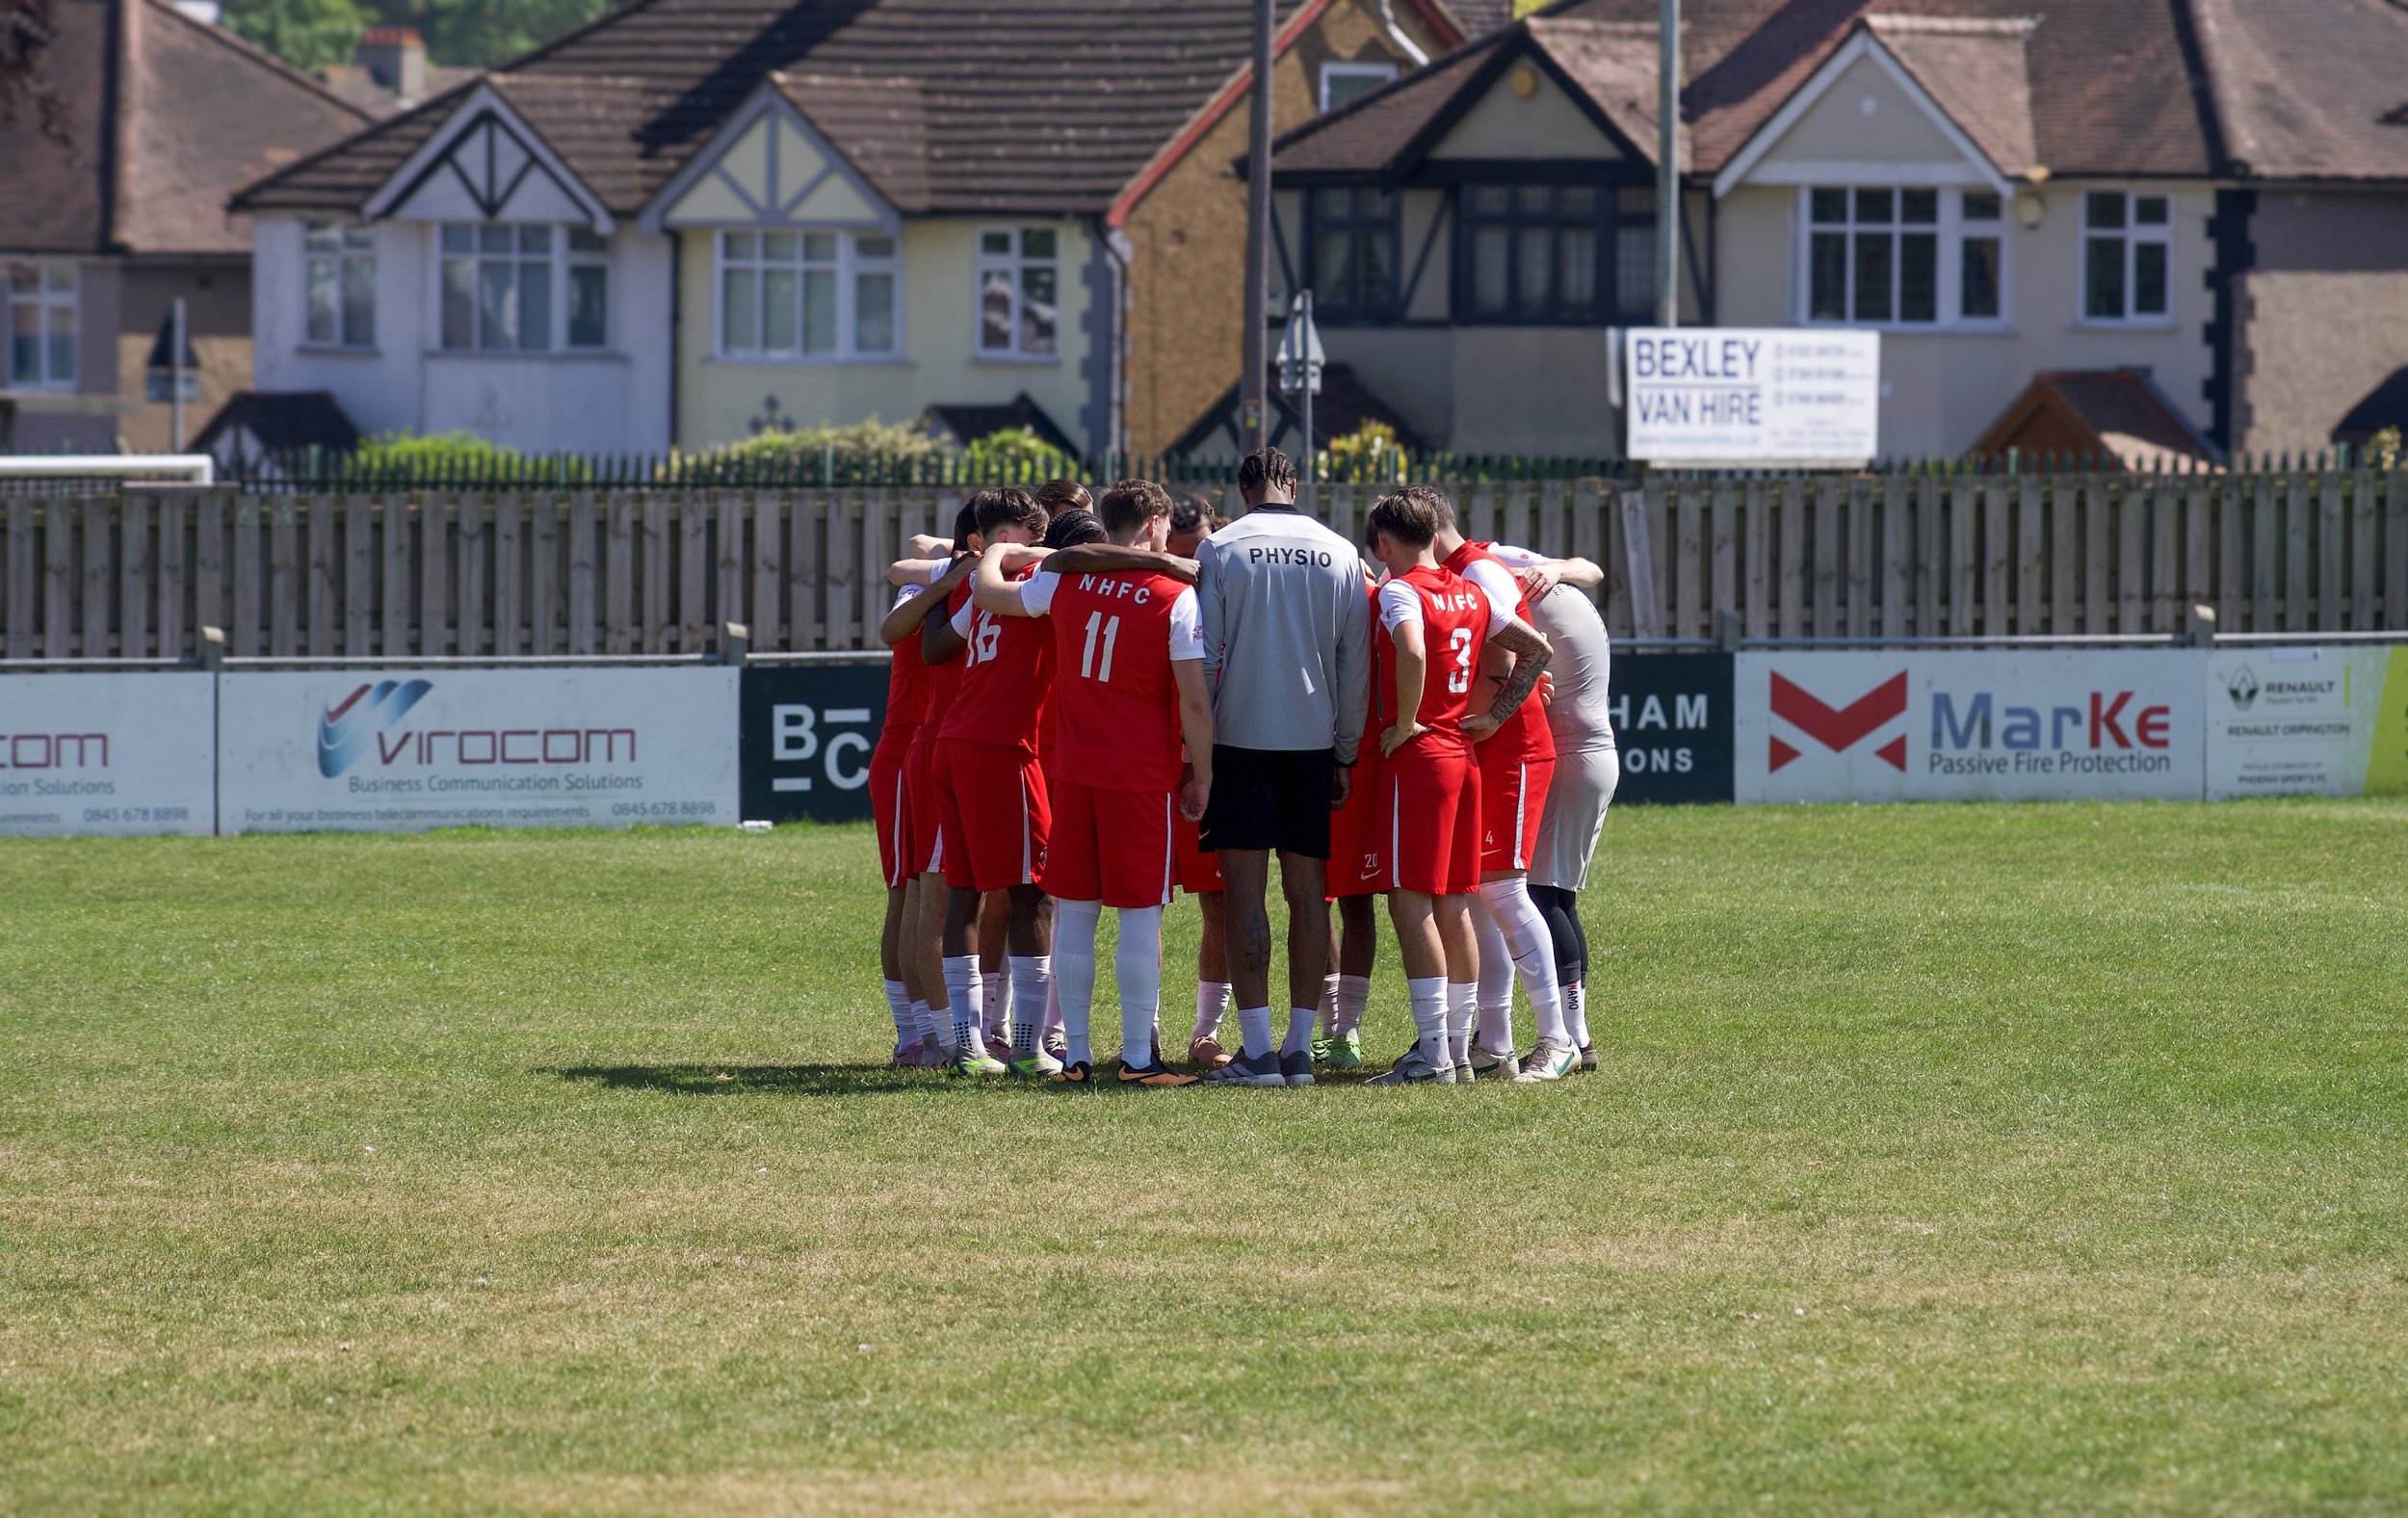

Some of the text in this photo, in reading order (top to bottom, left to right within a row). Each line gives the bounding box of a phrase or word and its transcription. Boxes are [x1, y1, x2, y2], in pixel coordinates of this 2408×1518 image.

[1636, 339, 1761, 378] BEXLEY
[1636, 393, 1690, 424] VAN
[1699, 392, 1762, 424] HIRE
[1249, 547, 1332, 568] PHYSIO
[1079, 573, 1150, 605] NHFC
[1081, 610, 1120, 683] 11
[1448, 627, 1473, 694] 3
[2265, 680, 2336, 694] RENAULT
[2227, 722, 2351, 737] RENAULT ORPINGTON
[1929, 750, 2171, 774] Passive Fire Protection
[34, 777, 117, 796] Solutions
[349, 772, 643, 793] Business Communication Solutions
[83, 807, 120, 822] 0845
[122, 806, 149, 822] 678
[317, 808, 372, 821] business
[374, 806, 504, 822] telecommunications
[507, 806, 589, 822] requirements
[612, 802, 647, 817] 0845
[650, 801, 677, 816] 678
[680, 800, 716, 815] 8898
[1485, 830, 1494, 845] 4
[1364, 852, 1377, 868] 20
